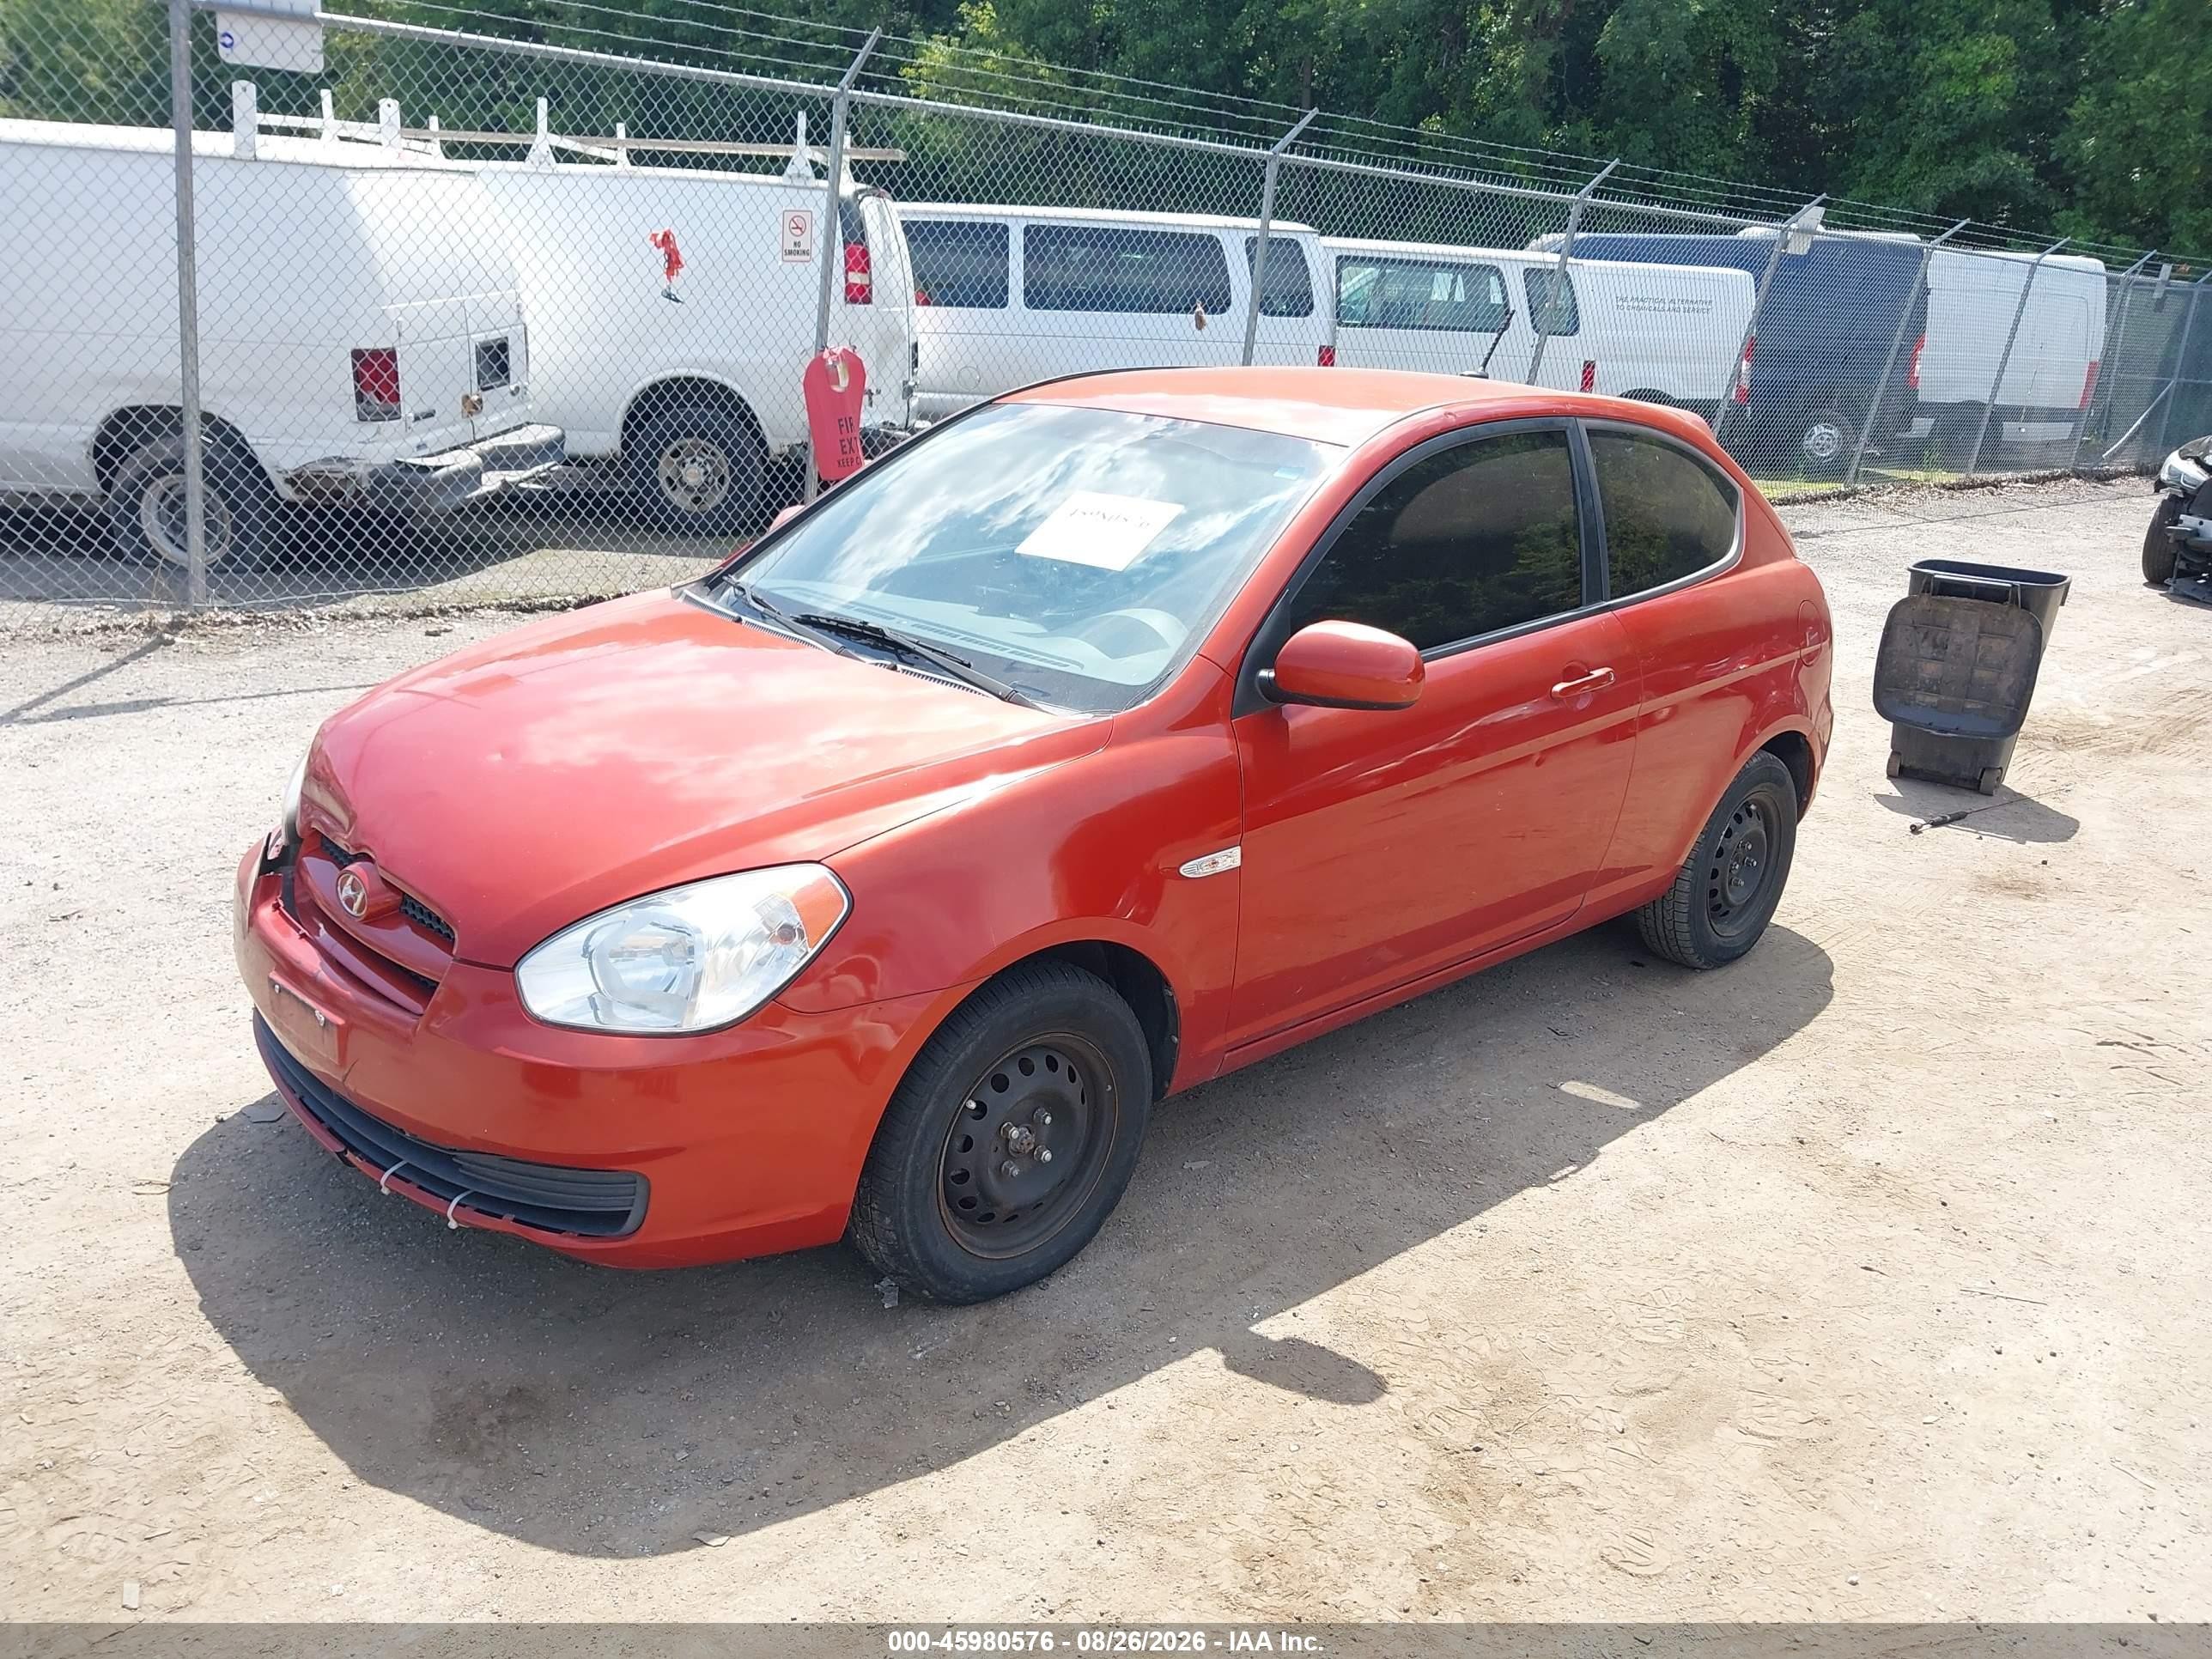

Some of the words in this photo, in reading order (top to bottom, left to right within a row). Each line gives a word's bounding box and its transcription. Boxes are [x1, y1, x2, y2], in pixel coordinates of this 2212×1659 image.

[784, 248, 810, 257] SMOKING
[1630, 296, 1667, 305] PRACTICAL
[1626, 304, 1666, 313] CHEMICALS
[837, 457, 854, 468] KEEP
